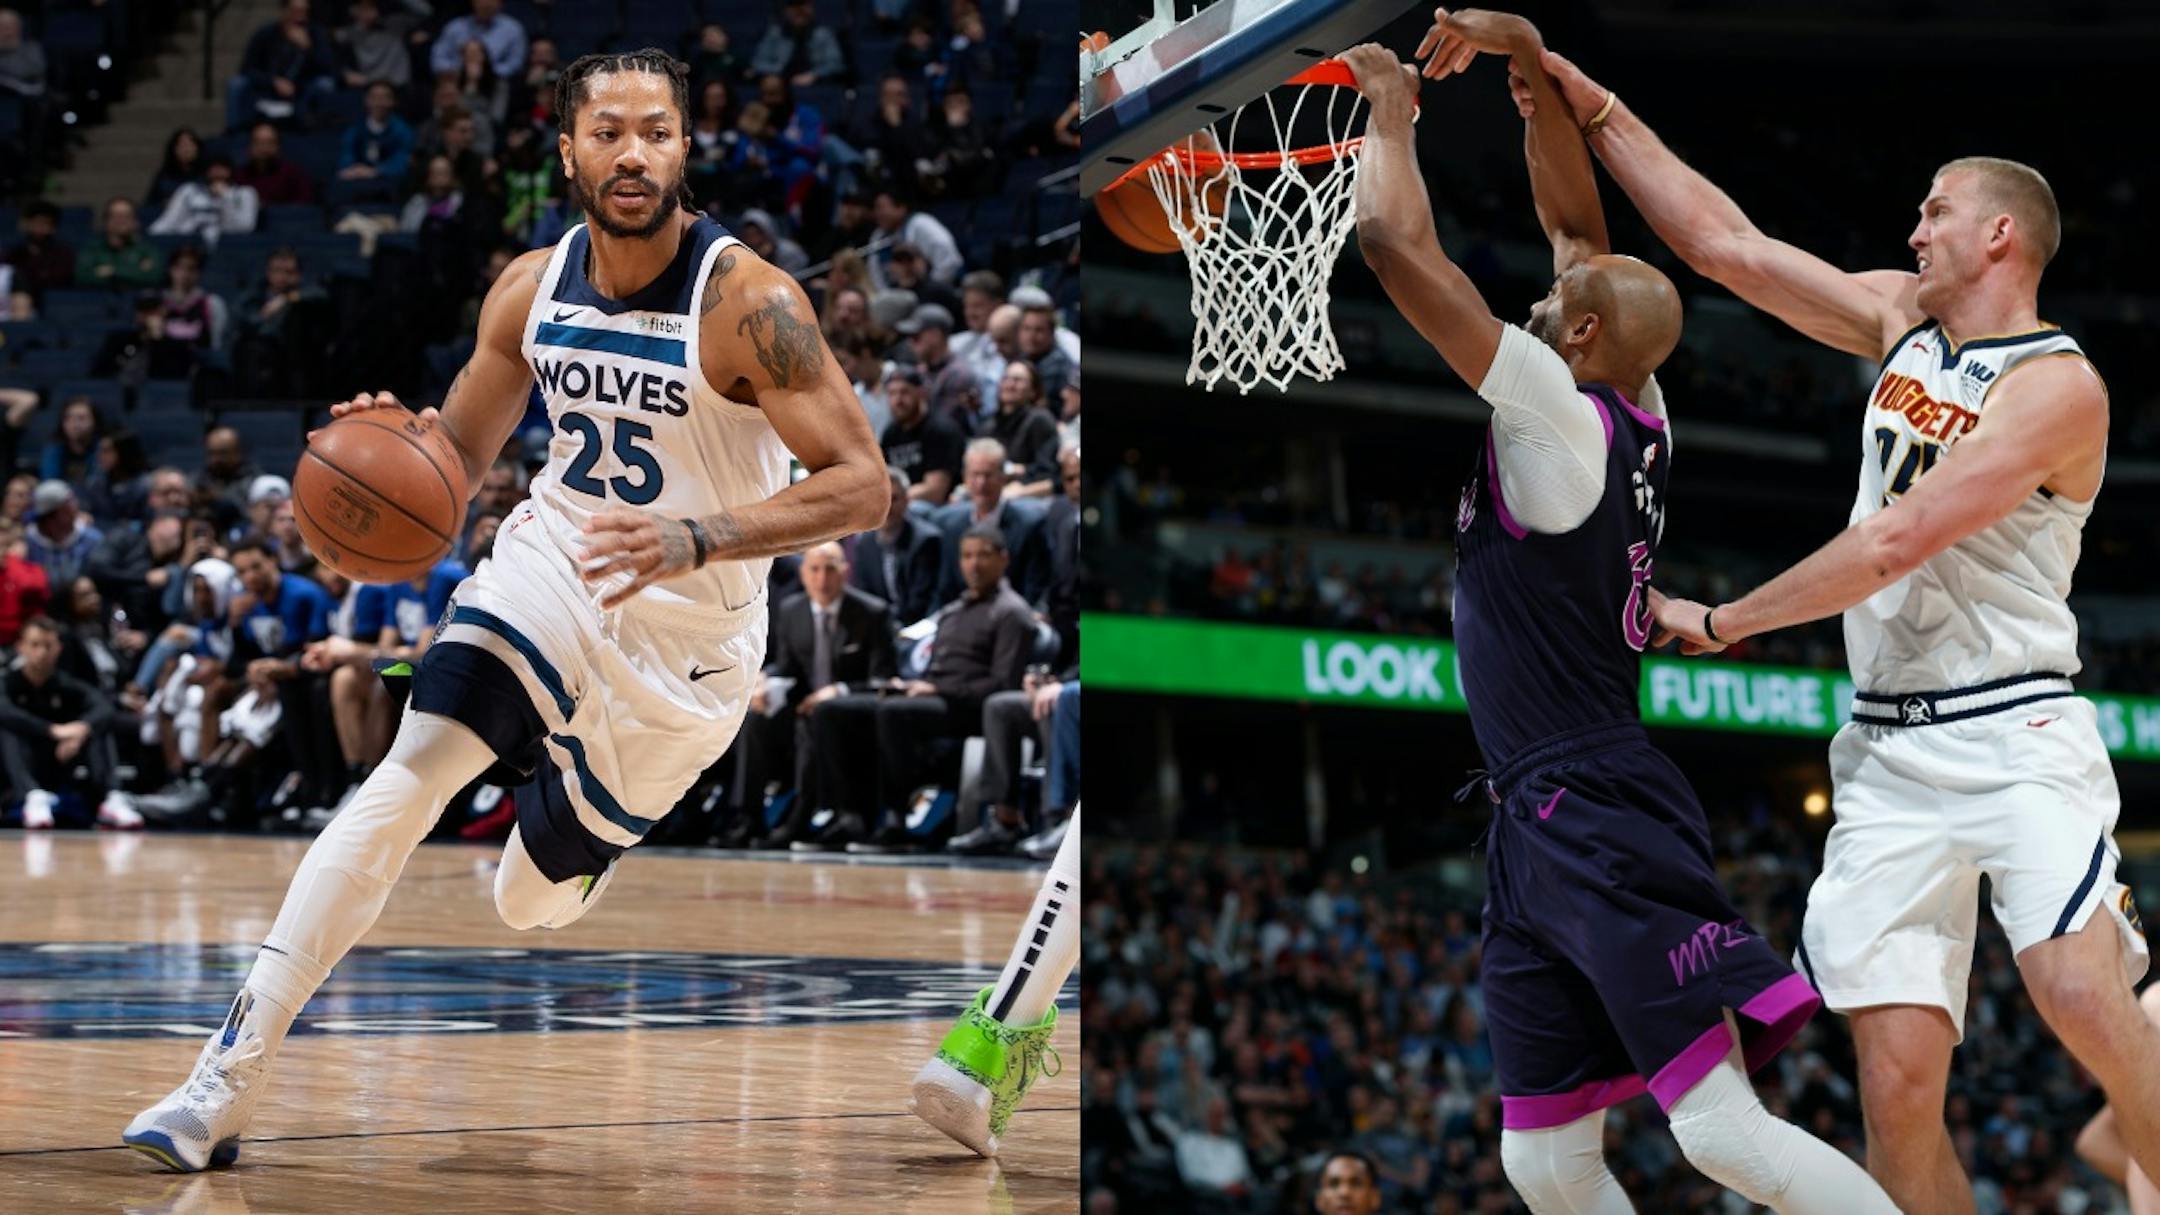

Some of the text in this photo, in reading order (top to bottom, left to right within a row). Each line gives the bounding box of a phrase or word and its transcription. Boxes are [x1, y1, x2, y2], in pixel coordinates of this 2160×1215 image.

[650, 316, 682, 334] fitbit
[534, 357, 689, 417] WOLVES
[1964, 359, 1996, 383] WU
[557, 411, 664, 505] 25
[1302, 638, 1443, 700] LOOK
[1651, 664, 1826, 730] FUTURE
